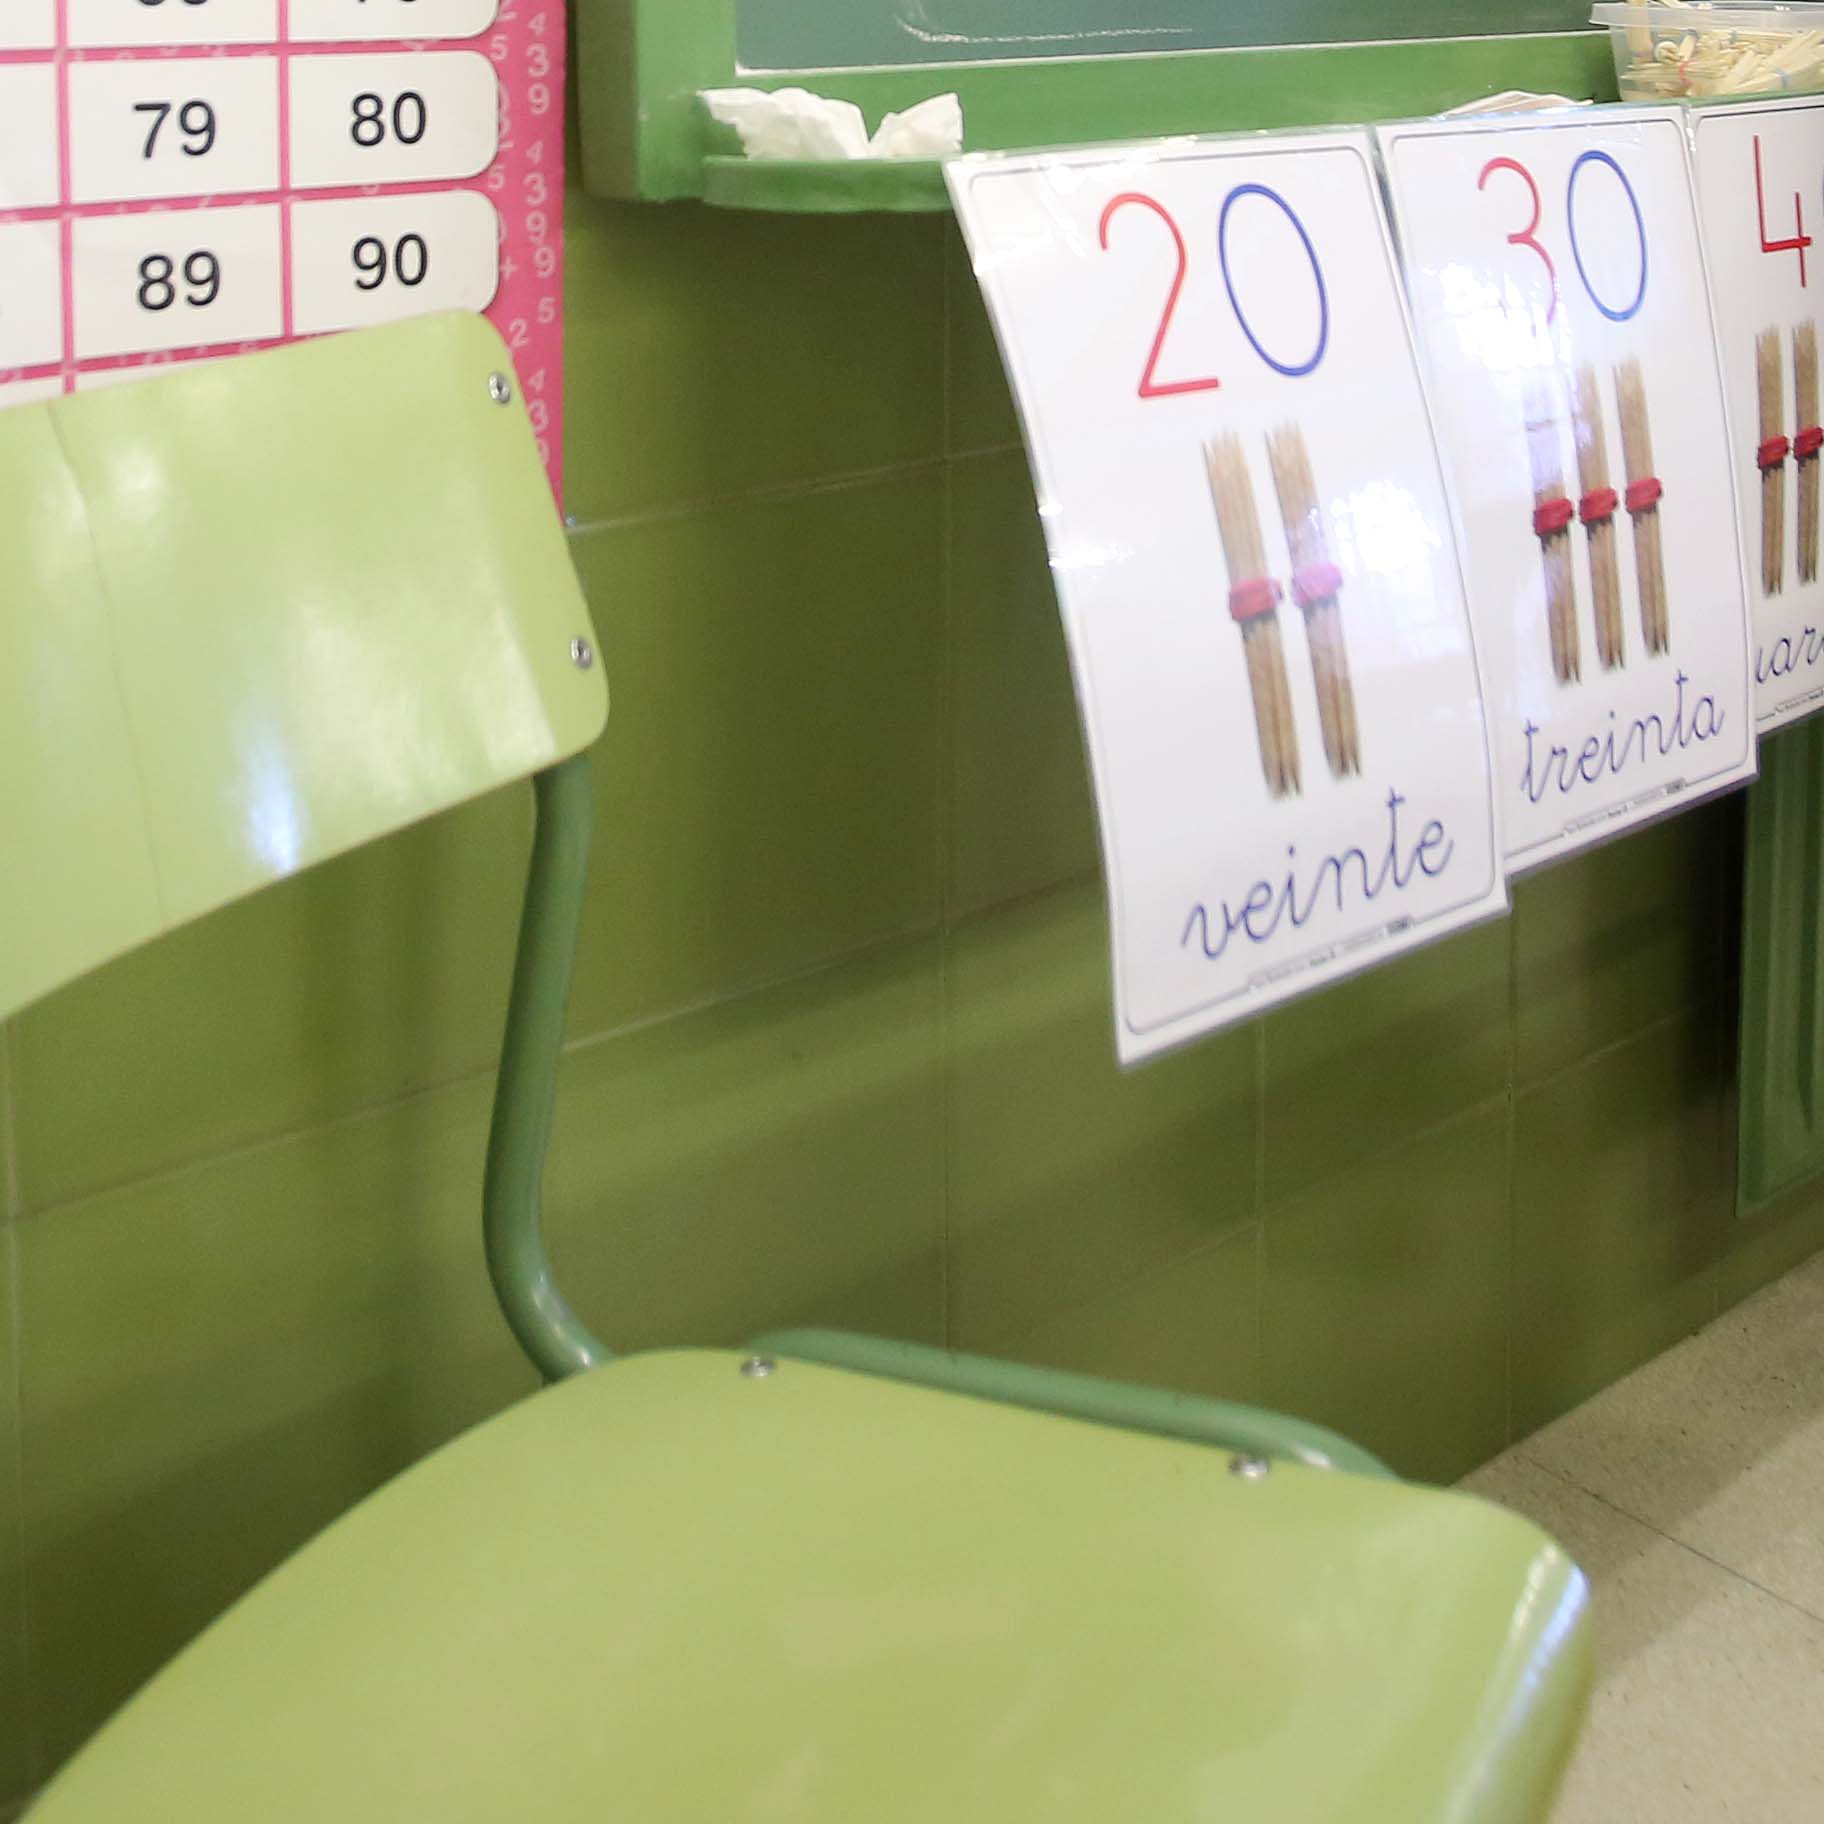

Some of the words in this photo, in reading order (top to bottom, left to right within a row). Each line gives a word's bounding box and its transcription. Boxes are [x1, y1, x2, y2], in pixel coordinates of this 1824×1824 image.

[132, 98, 218, 161] 79
[348, 89, 429, 150] 80
[135, 248, 223, 314] 89
[350, 231, 431, 293] 90
[1098, 184, 1330, 399] 20
[1476, 149, 1649, 326] 30
[1519, 670, 1726, 805] treinta
[1182, 788, 1455, 962] veinte
